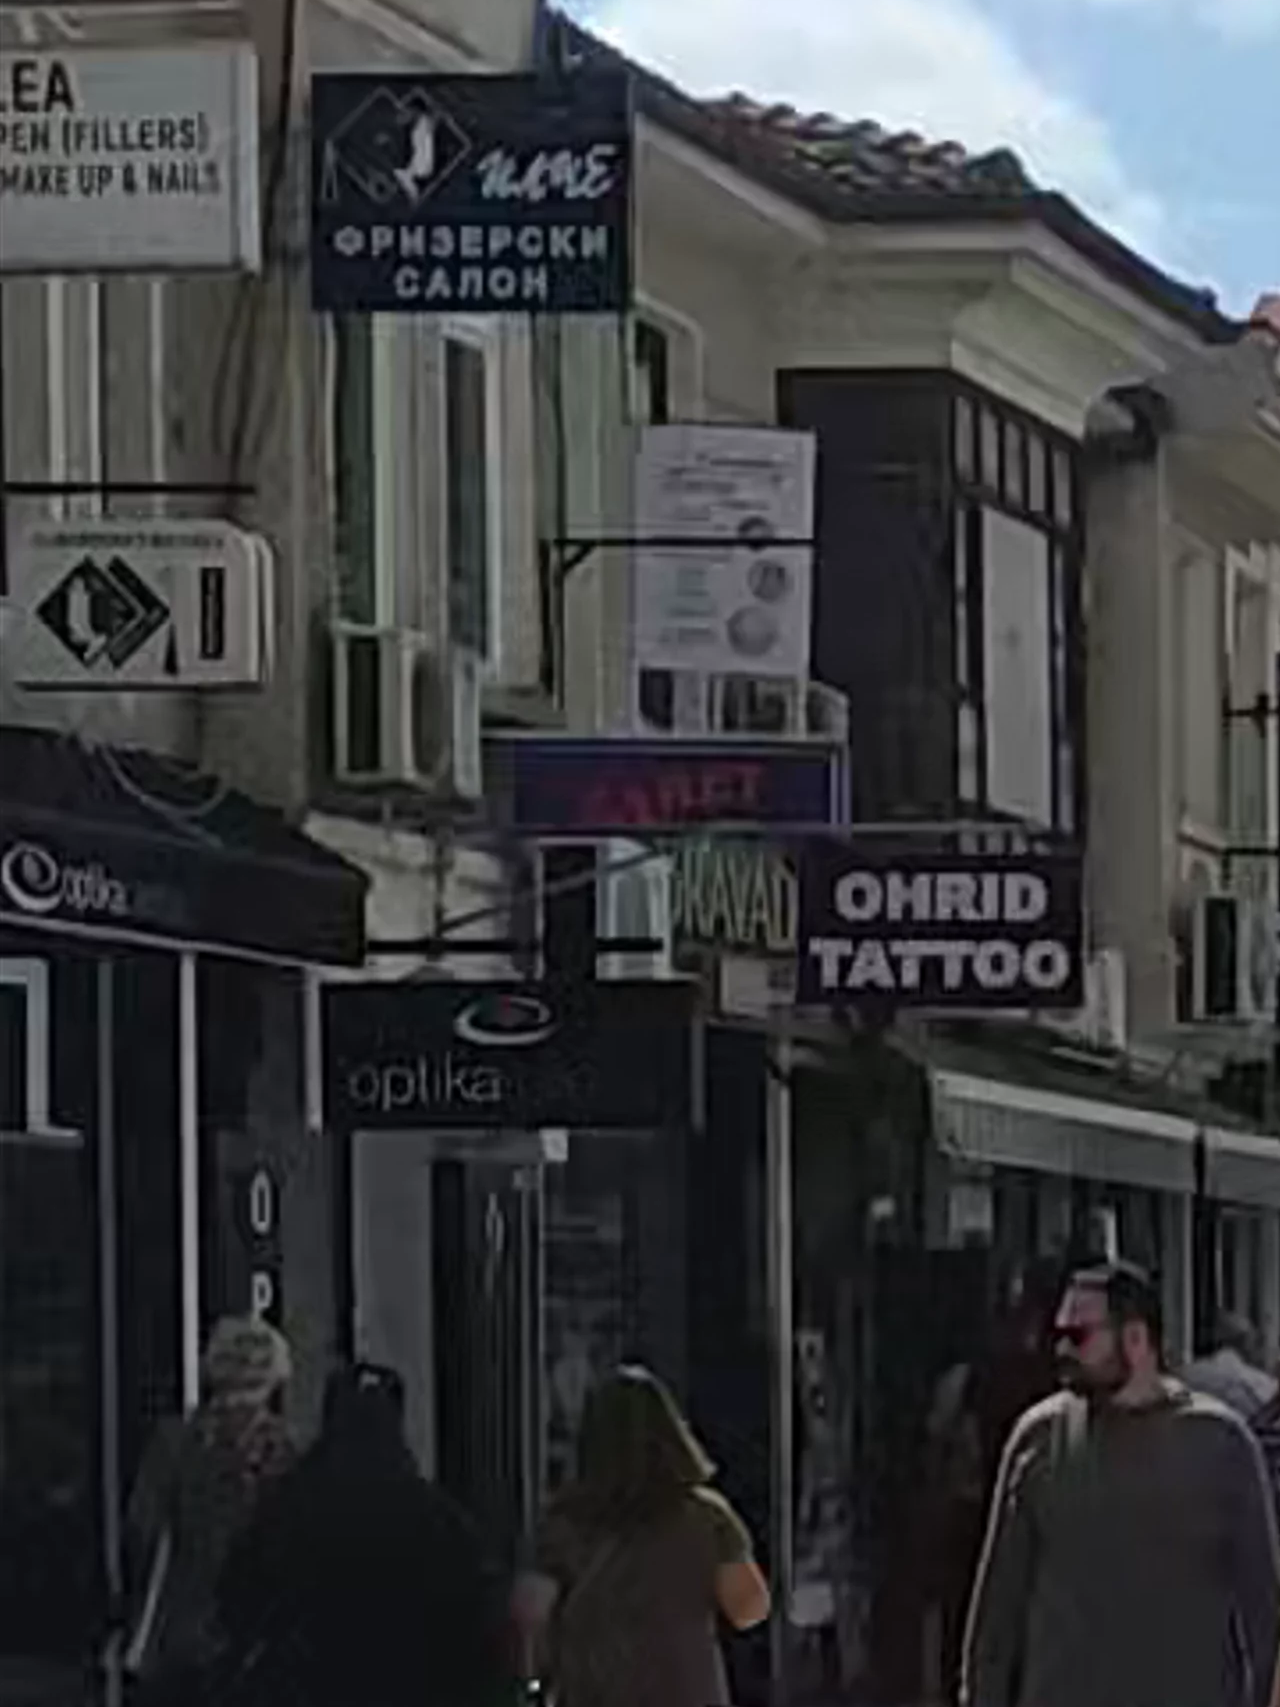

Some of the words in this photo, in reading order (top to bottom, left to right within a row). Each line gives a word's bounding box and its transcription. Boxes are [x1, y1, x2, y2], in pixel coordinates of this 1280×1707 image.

[0, 60, 73, 112] EA
[332, 225, 608, 260] ФРИЗЕРСКИ
[392, 264, 548, 300] САЛОН
[834, 870, 1048, 923] OHRID
[808, 936, 1070, 991] TATTOO
[349, 1051, 503, 1112] optika
